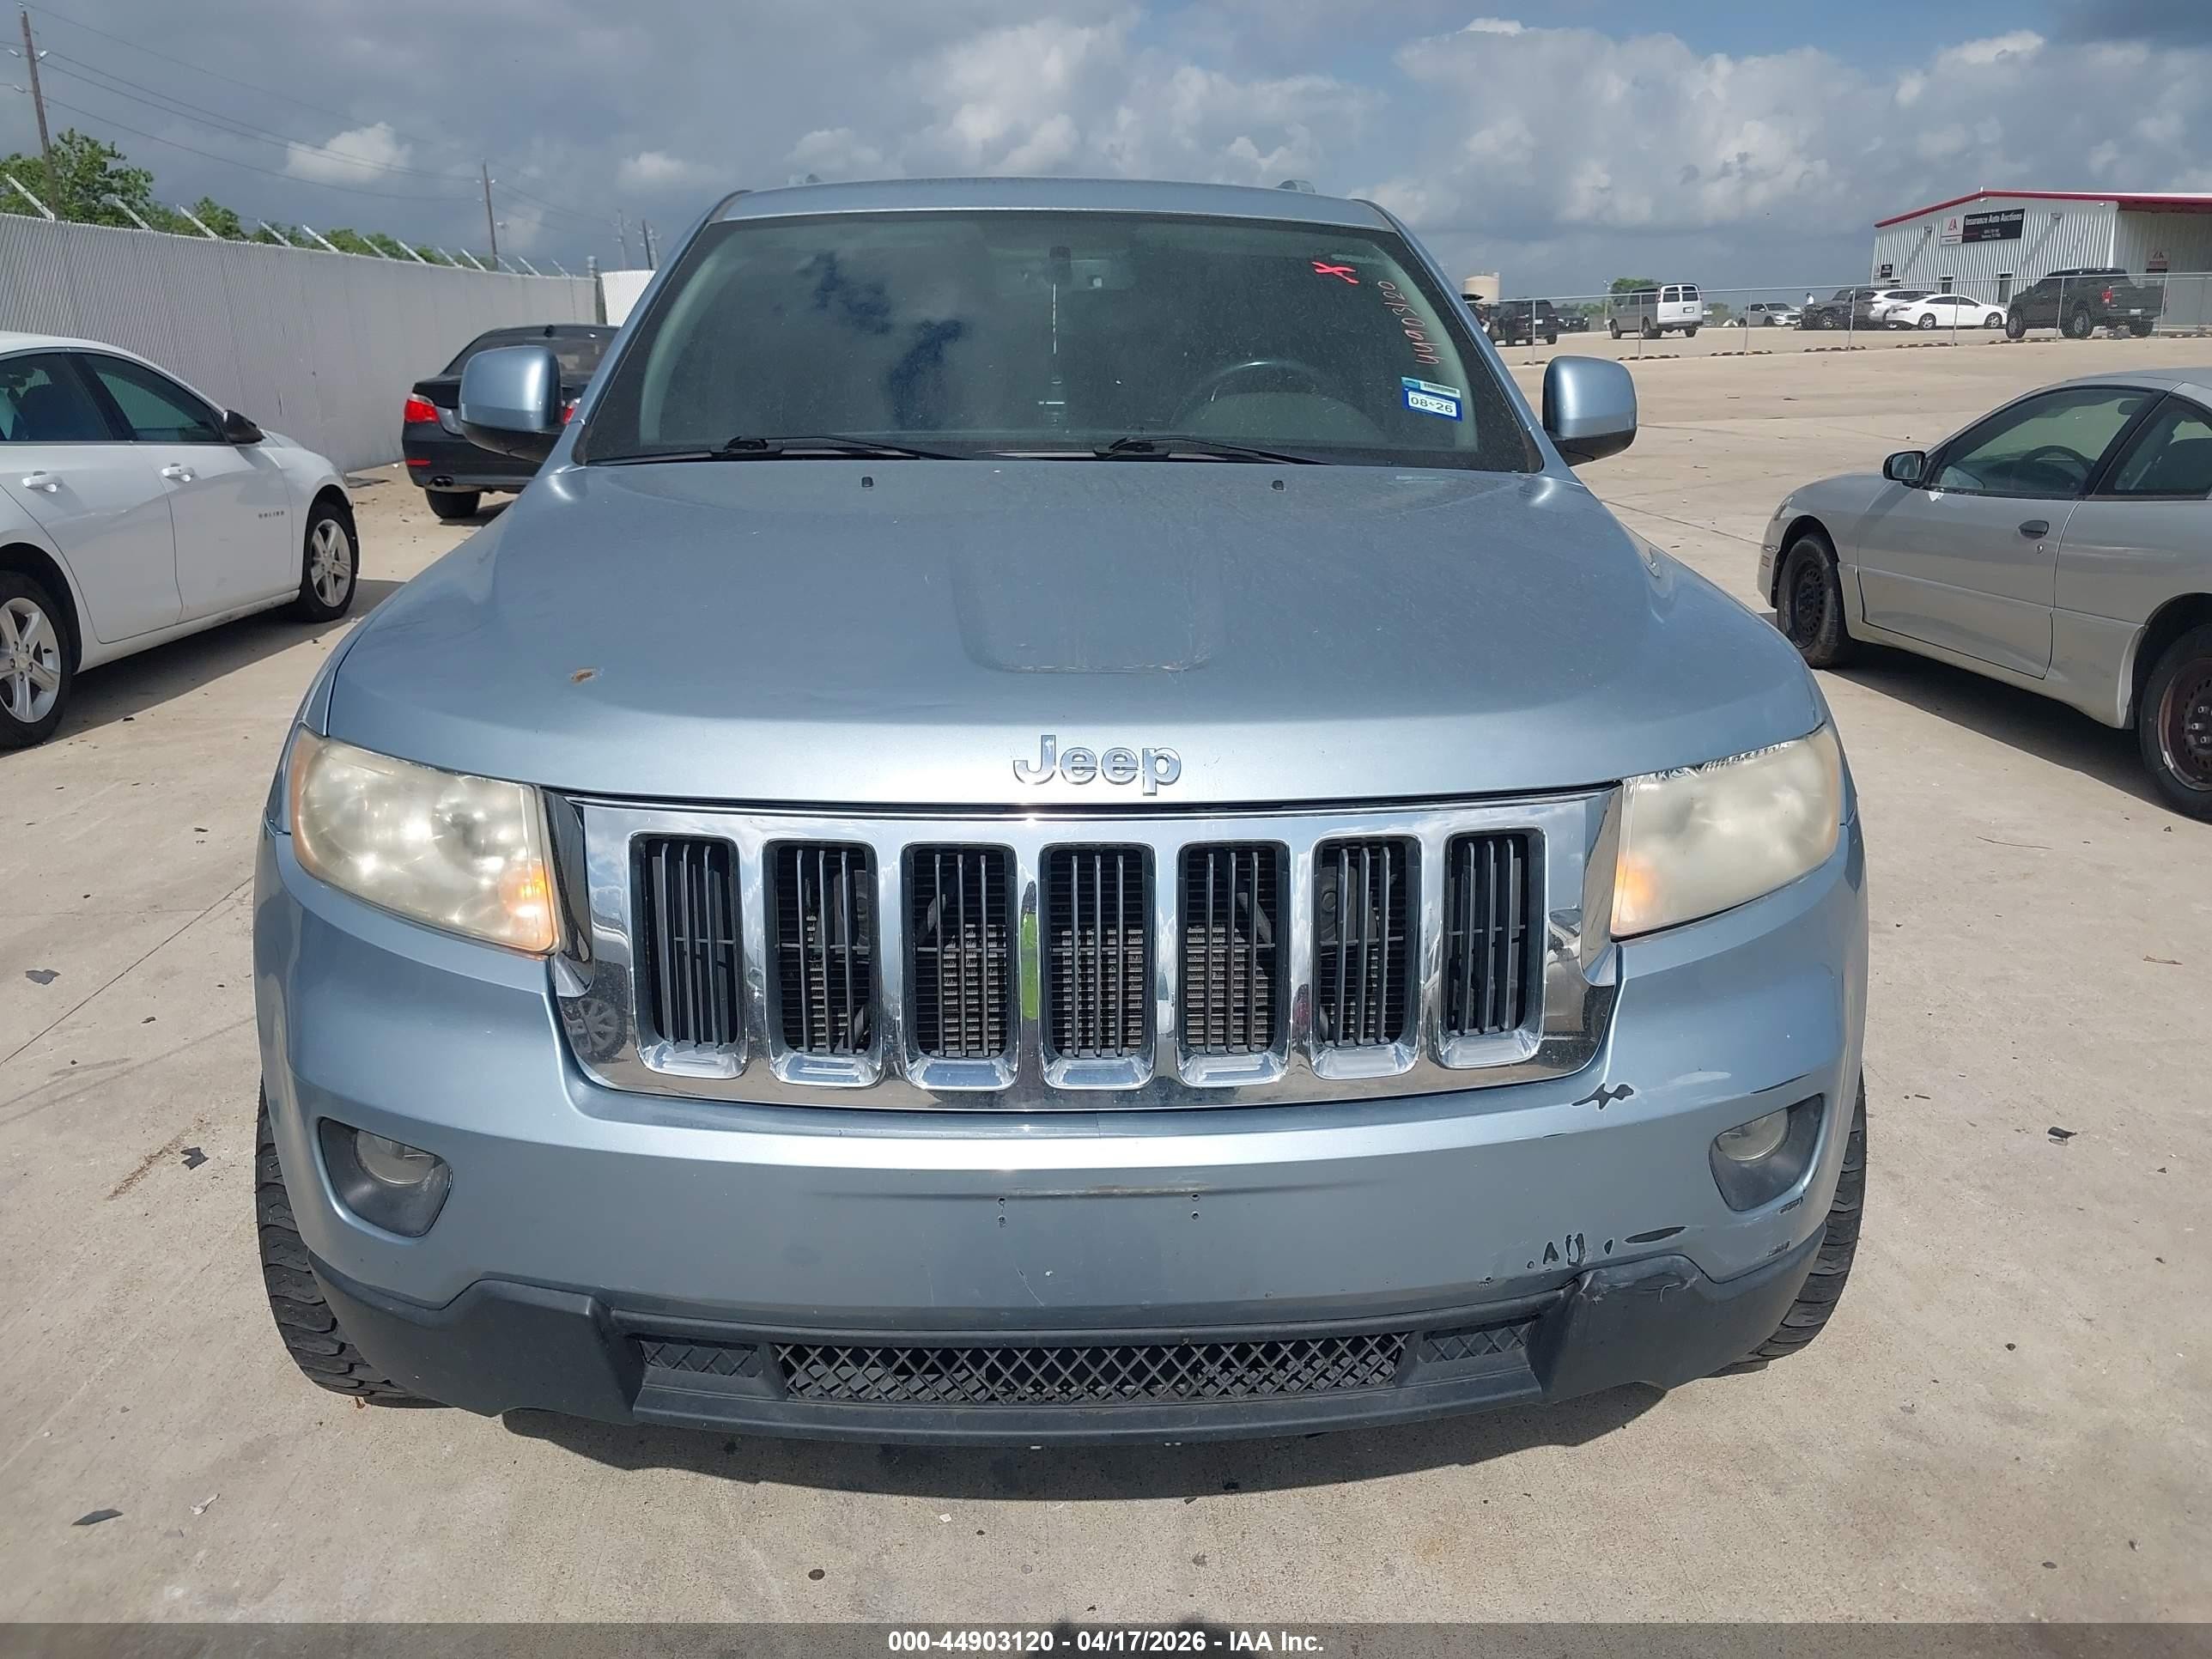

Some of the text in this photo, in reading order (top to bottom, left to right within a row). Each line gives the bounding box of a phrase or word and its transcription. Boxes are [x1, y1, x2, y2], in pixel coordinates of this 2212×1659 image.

[1988, 214, 2000, 223] Auto
[2000, 212, 2023, 222] Auctions
[1411, 397, 1454, 413] 08-26
[1012, 734, 1182, 796] Jeep
